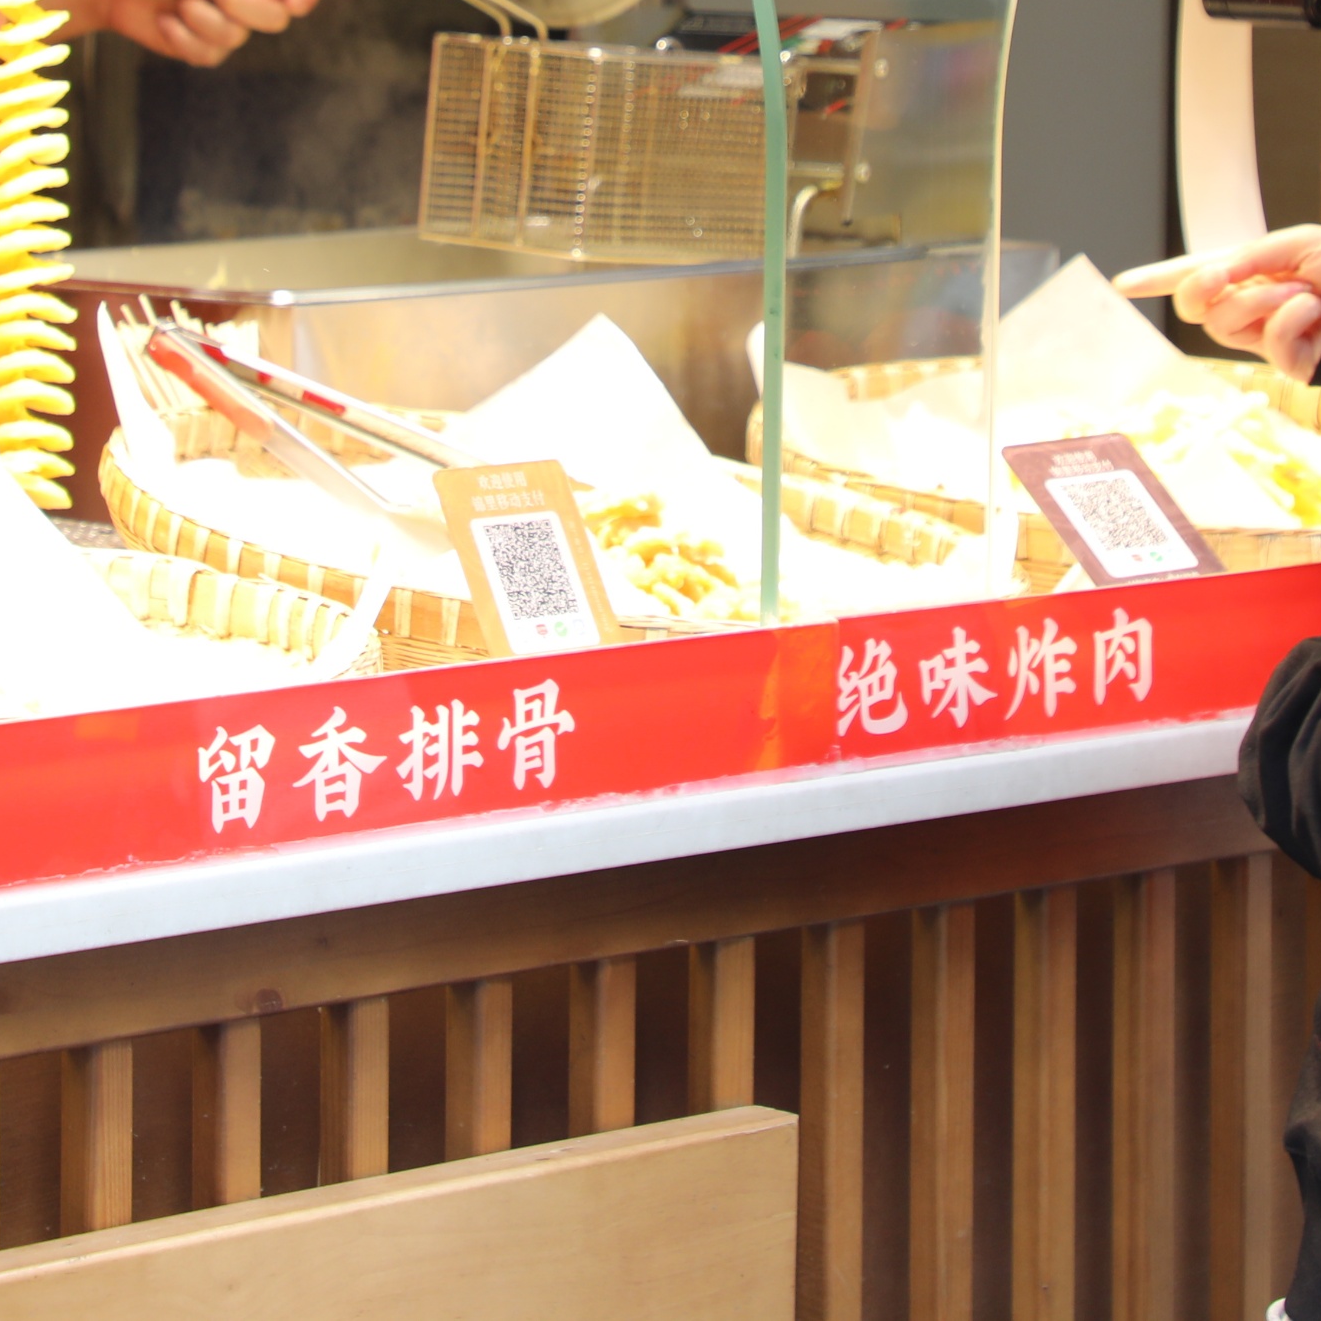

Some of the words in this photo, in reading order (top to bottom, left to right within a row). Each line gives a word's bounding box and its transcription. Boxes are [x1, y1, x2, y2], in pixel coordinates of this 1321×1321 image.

[837, 607, 1153, 736] 绝味炸肉
[198, 678, 575, 834] 留香排骨
